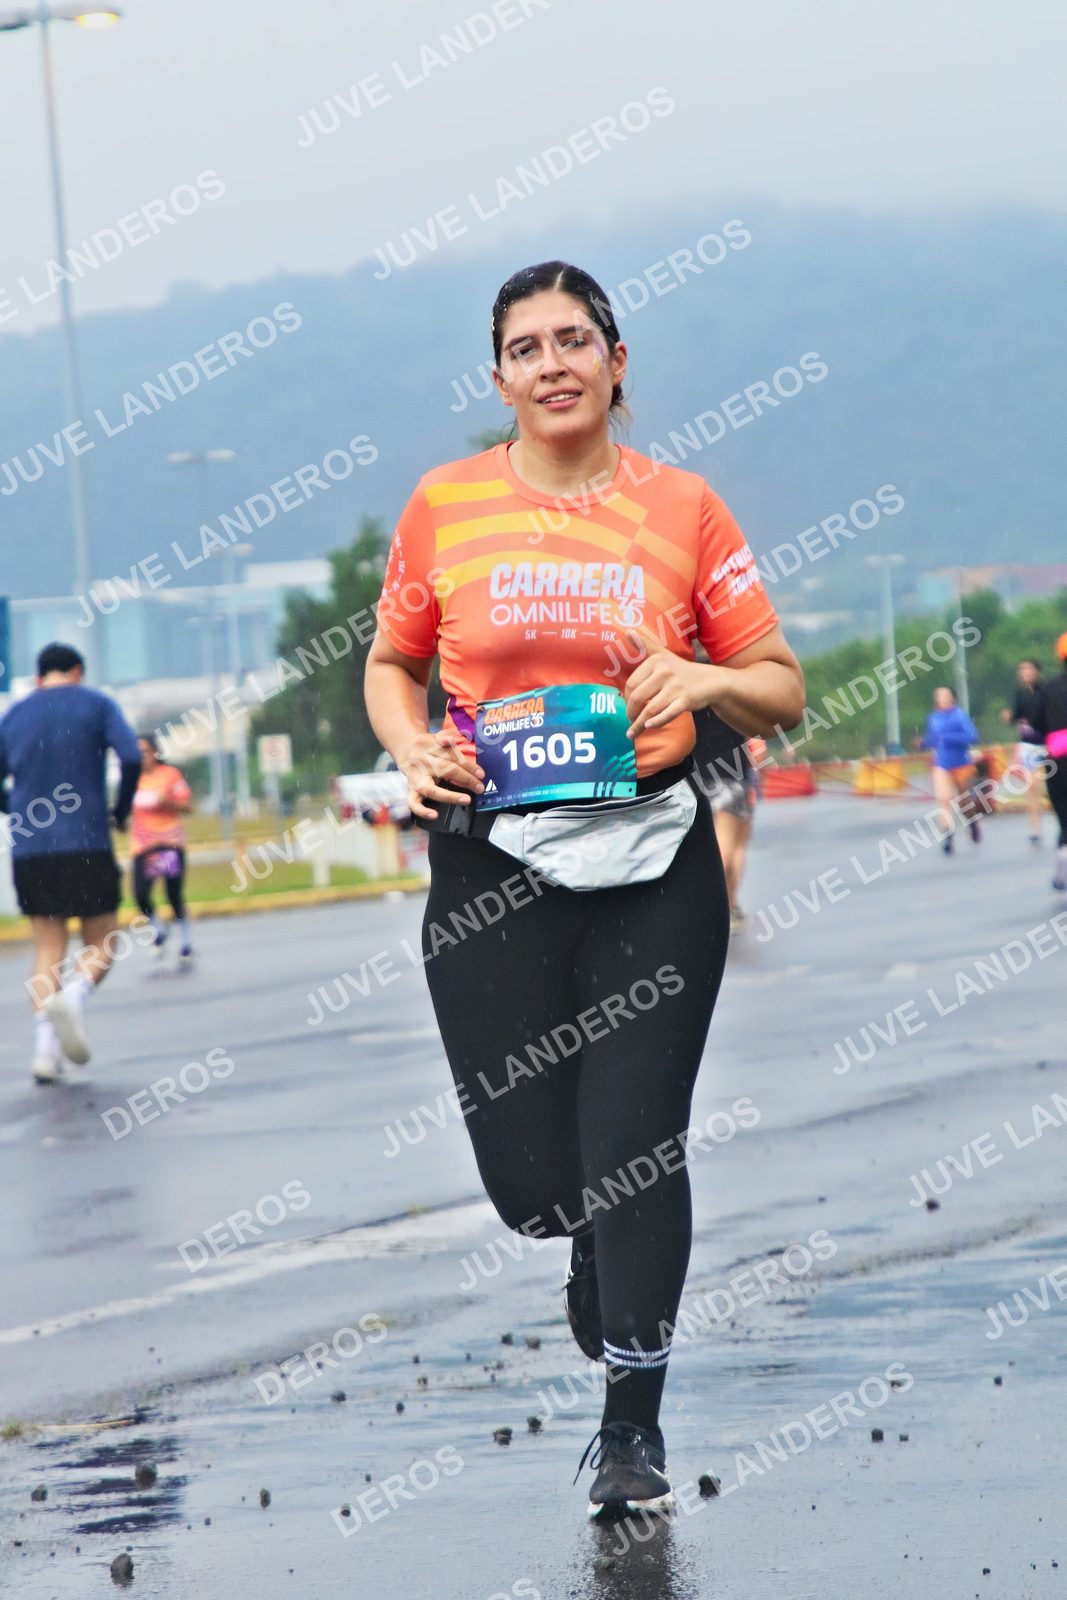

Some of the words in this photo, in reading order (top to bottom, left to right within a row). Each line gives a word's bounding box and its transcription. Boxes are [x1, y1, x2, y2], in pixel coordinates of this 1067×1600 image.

[490, 561, 645, 600] CARRERA
[490, 601, 612, 626] OMNILIFE
[561, 628, 577, 639] 10K
[484, 697, 544, 725] CARRERA
[590, 692, 616, 714] 10K
[484, 717, 531, 737] OMNILIFE
[502, 731, 596, 771] 1605
